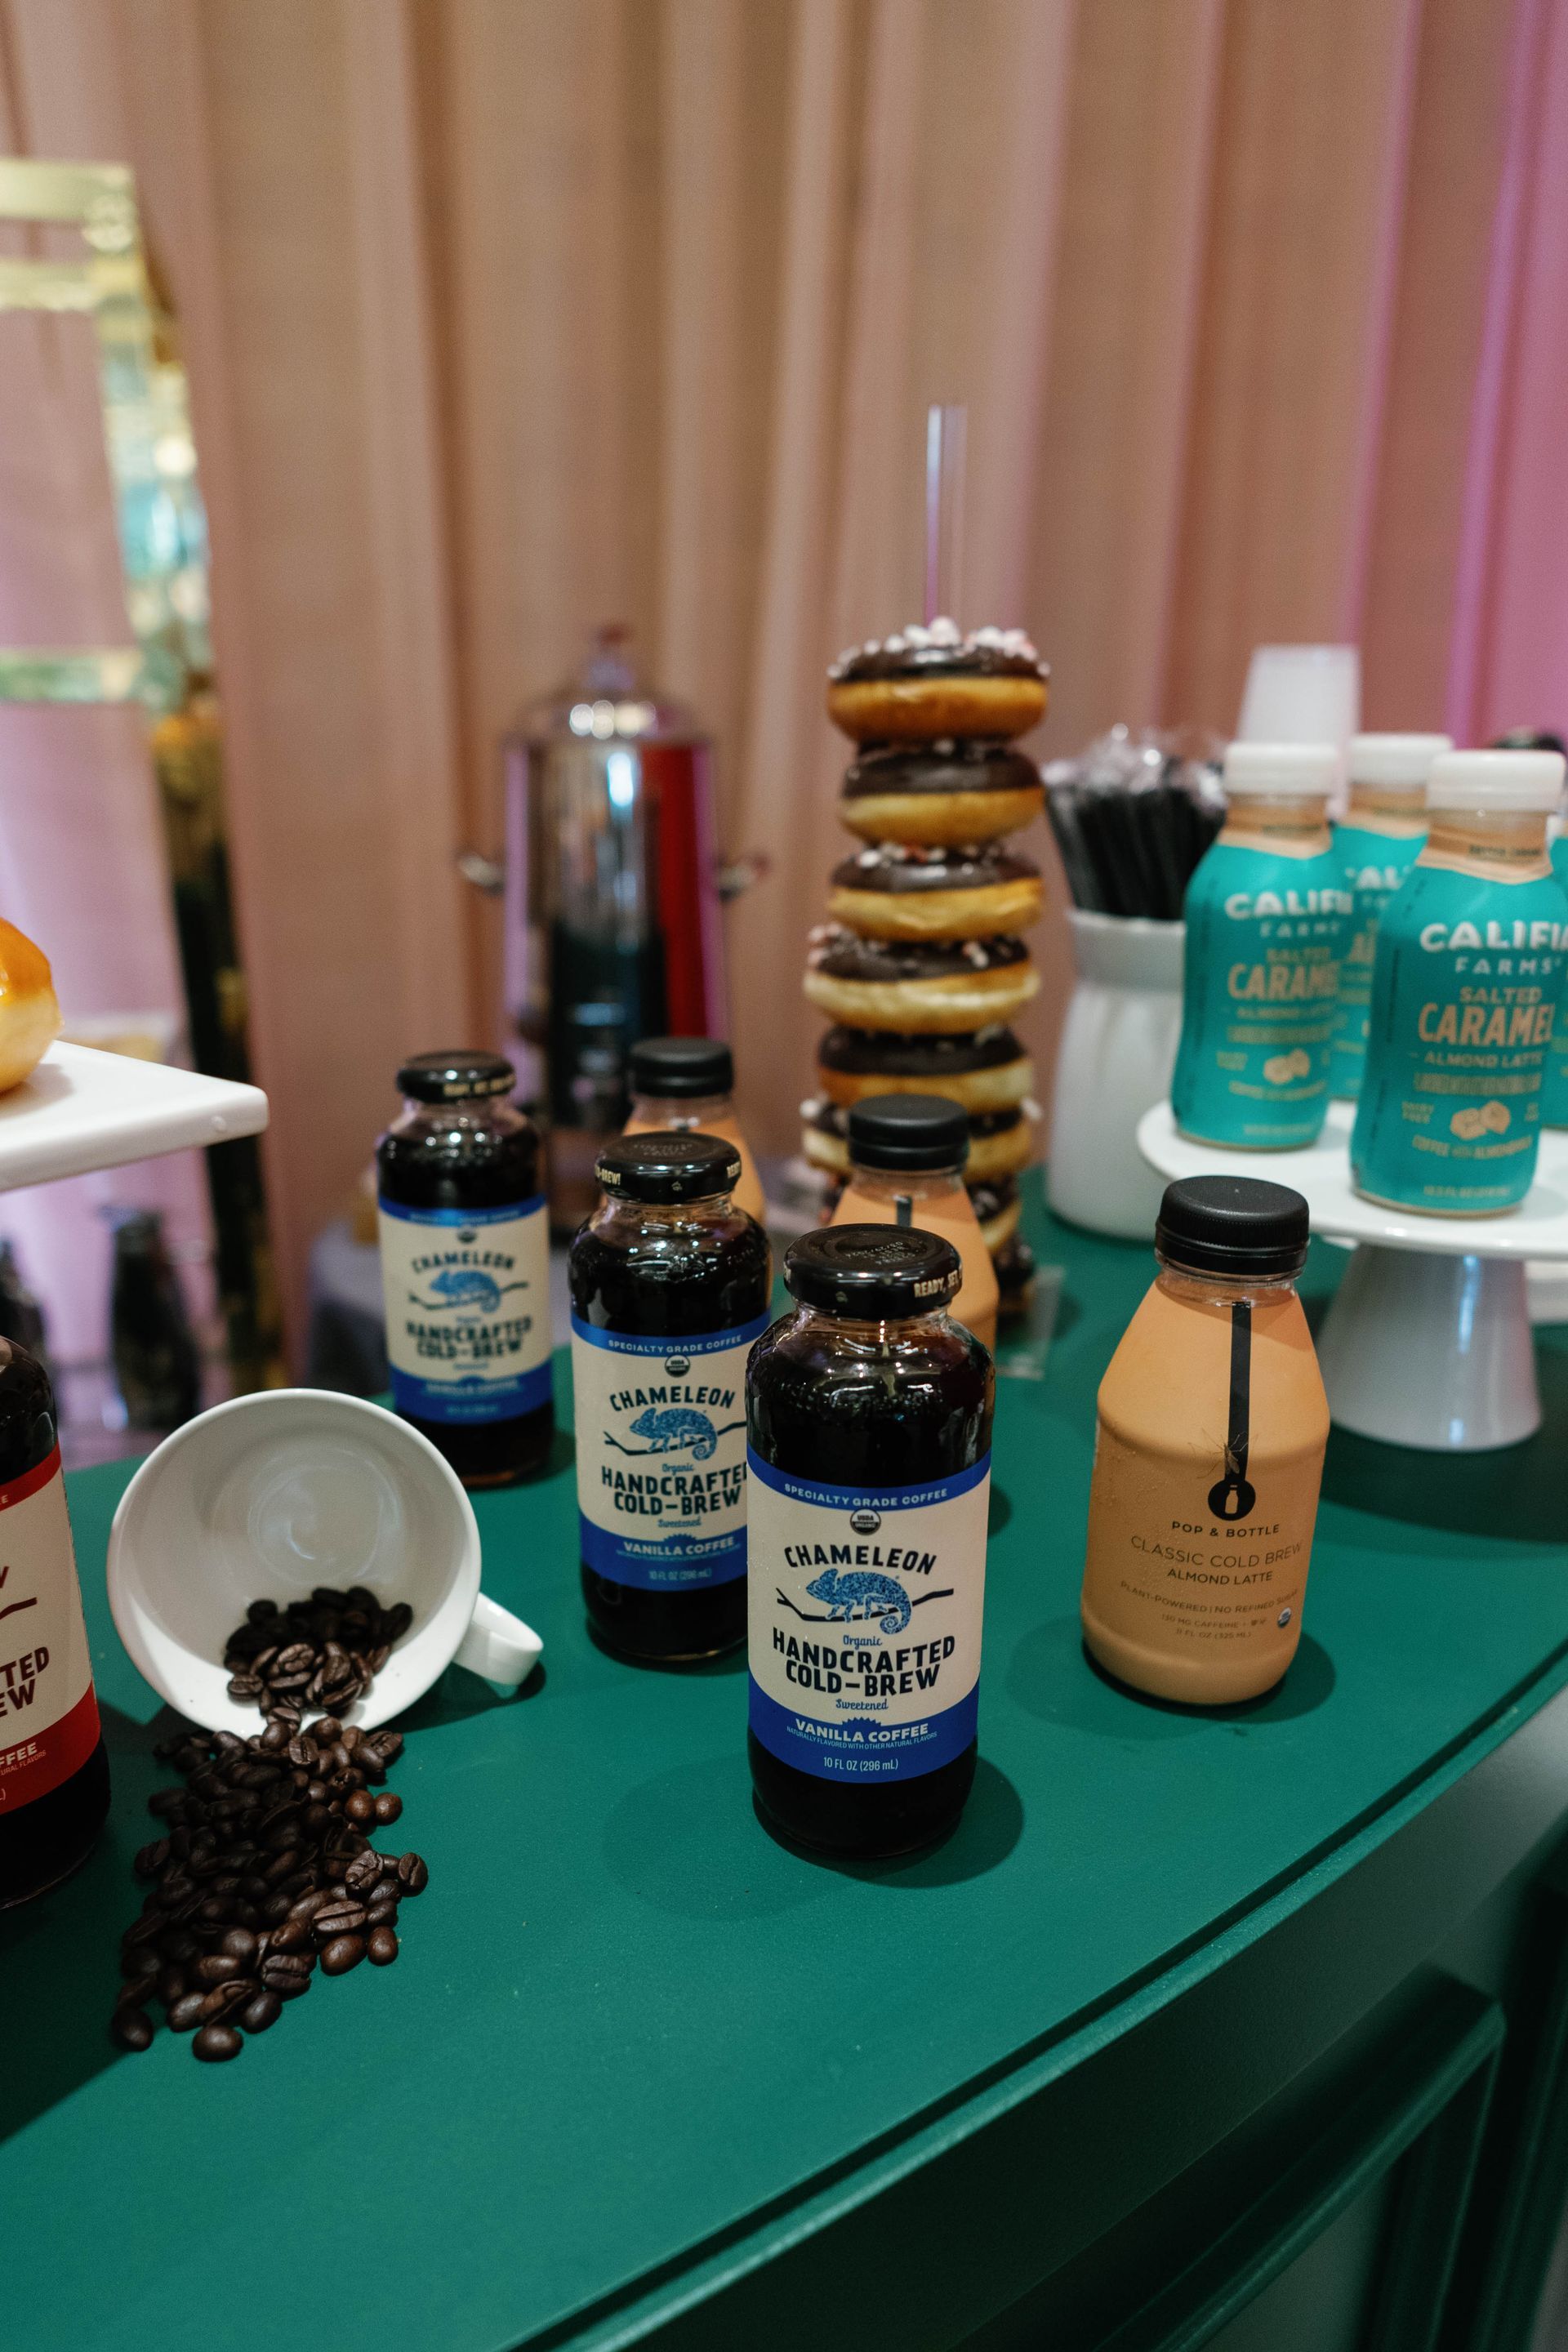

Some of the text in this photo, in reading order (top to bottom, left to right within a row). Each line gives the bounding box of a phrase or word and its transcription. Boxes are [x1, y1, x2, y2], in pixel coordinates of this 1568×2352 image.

[1459, 986, 1543, 1004] SALTED
[1423, 1051, 1498, 1069] ALMOND
[412, 1250, 515, 1274] CHAMELEON
[407, 1316, 532, 1342] HANDCRAFTED
[608, 1334, 742, 1354] SPECIALTY GRADE COFFEE
[609, 1385, 735, 1412] CHAMELEON
[613, 1485, 742, 1517] COLD-BREW
[784, 1483, 947, 1507] SPECIALTY GRADE COFFEE
[1171, 1520, 1280, 1539] POP & BOTTLE
[623, 1536, 735, 1556] VANILLA COFFEE
[1130, 1535, 1304, 1569] CLASSIC COLD BREW
[784, 1544, 937, 1575] CHAMELEON
[1167, 1568, 1273, 1585] ALMOND LATTE
[1214, 1604, 1232, 1614] NO
[1235, 1599, 1275, 1614] REFINED
[773, 1626, 956, 1674] HANDCRAFTED
[843, 1634, 882, 1650] Organic
[786, 1659, 941, 1698] COLD-BREW
[835, 1698, 889, 1711] Sweetened
[786, 1726, 817, 1743] NATURALLY
[817, 1737, 847, 1749] FLAVORED
[848, 1742, 864, 1750] WITH
[885, 1740, 913, 1750] NATURAL
[913, 1731, 938, 1744] FLAVORS
[795, 1717, 929, 1743] VANILLA COFFEE
[823, 1757, 899, 1772] 10 FL OZ (296 mL)
